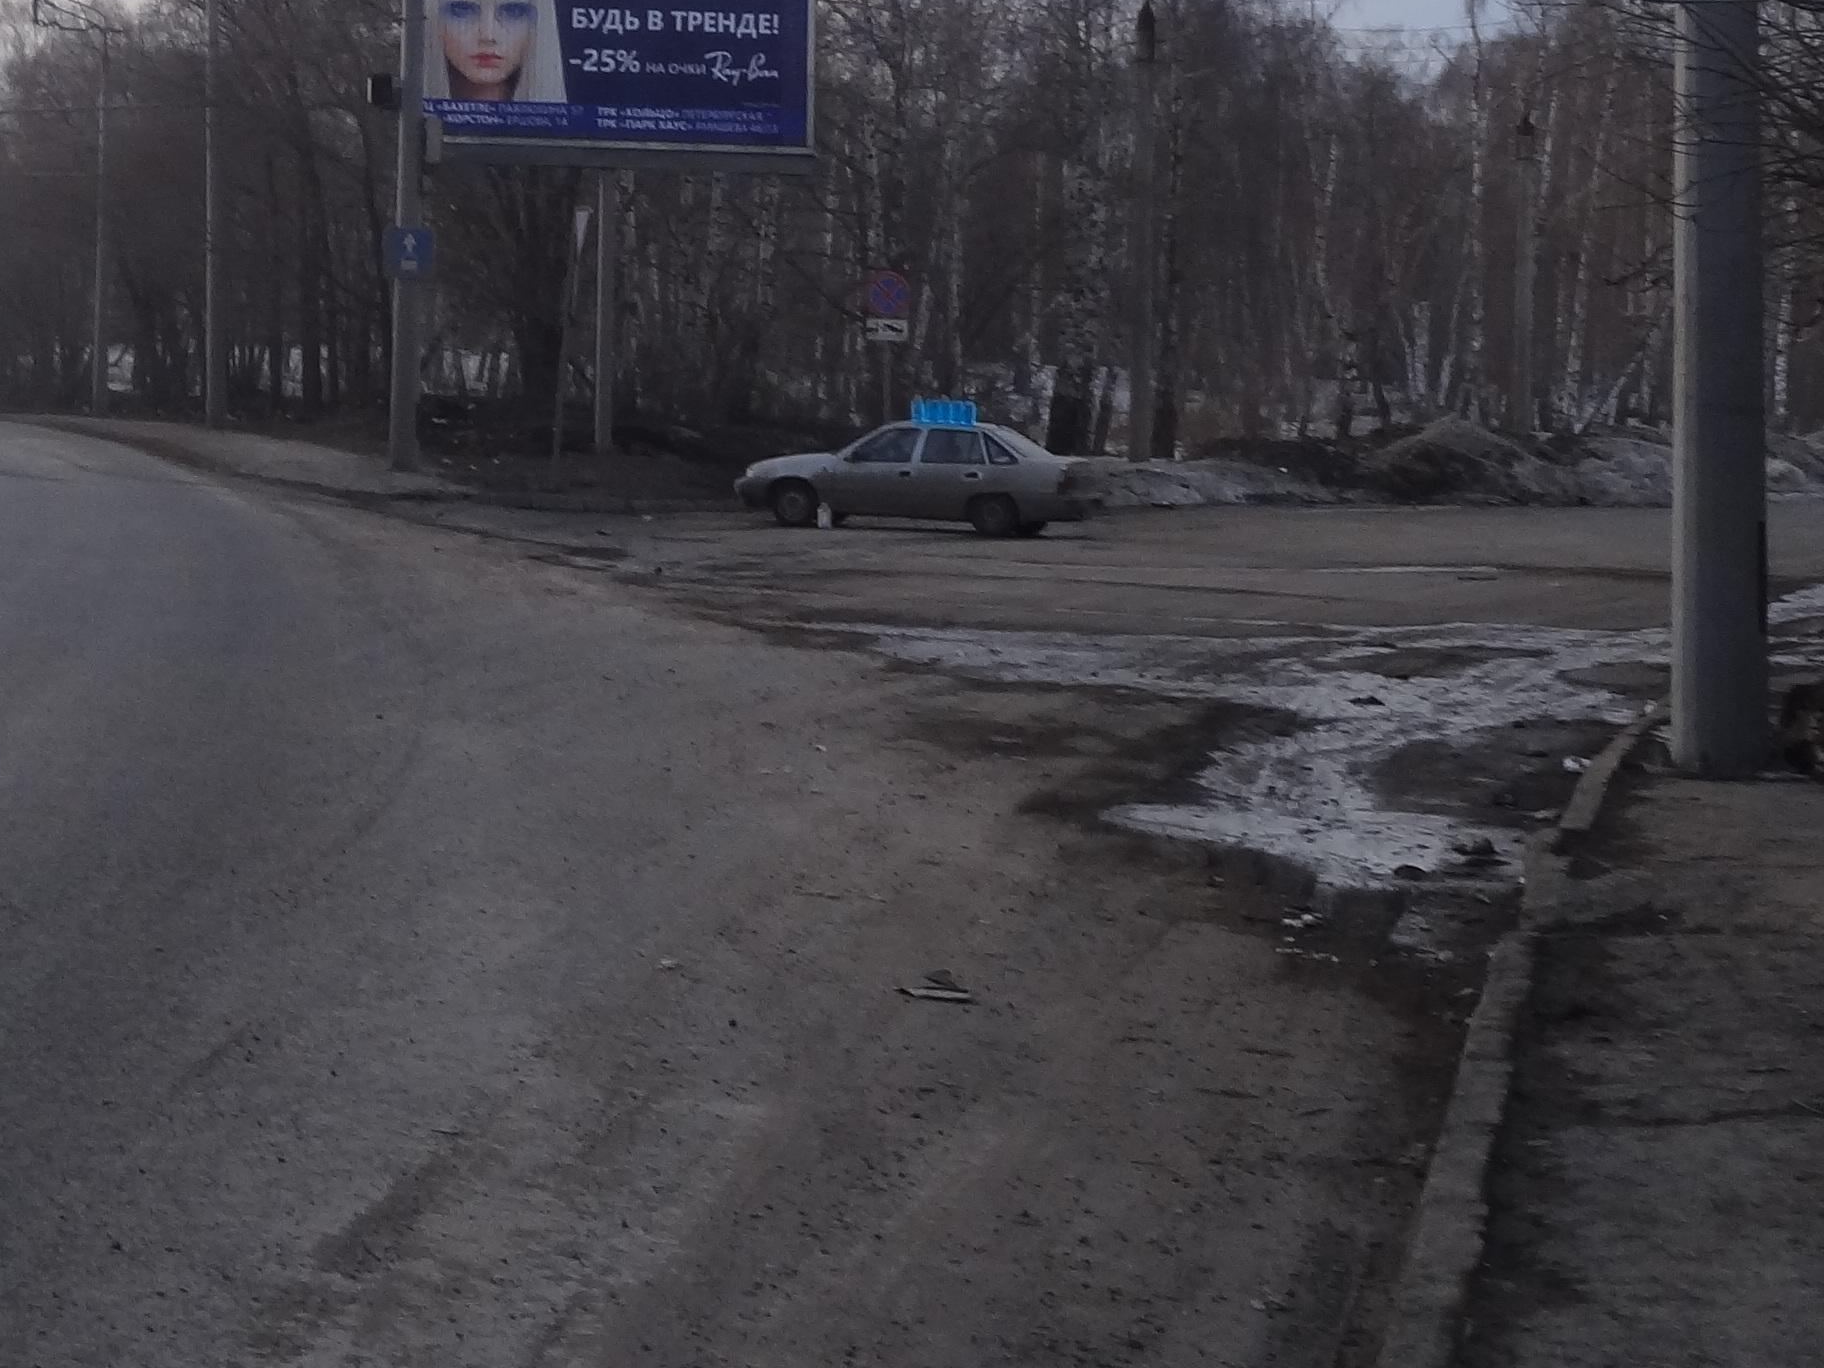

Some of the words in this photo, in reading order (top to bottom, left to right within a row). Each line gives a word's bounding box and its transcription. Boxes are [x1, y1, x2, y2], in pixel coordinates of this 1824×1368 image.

[571, 7, 640, 34] БУДЬ
[647, 9, 665, 31] В
[670, 10, 780, 38] ТРЕНДЕ!
[569, 48, 640, 73] -25%
[704, 50, 780, 87] Ray-Ban
